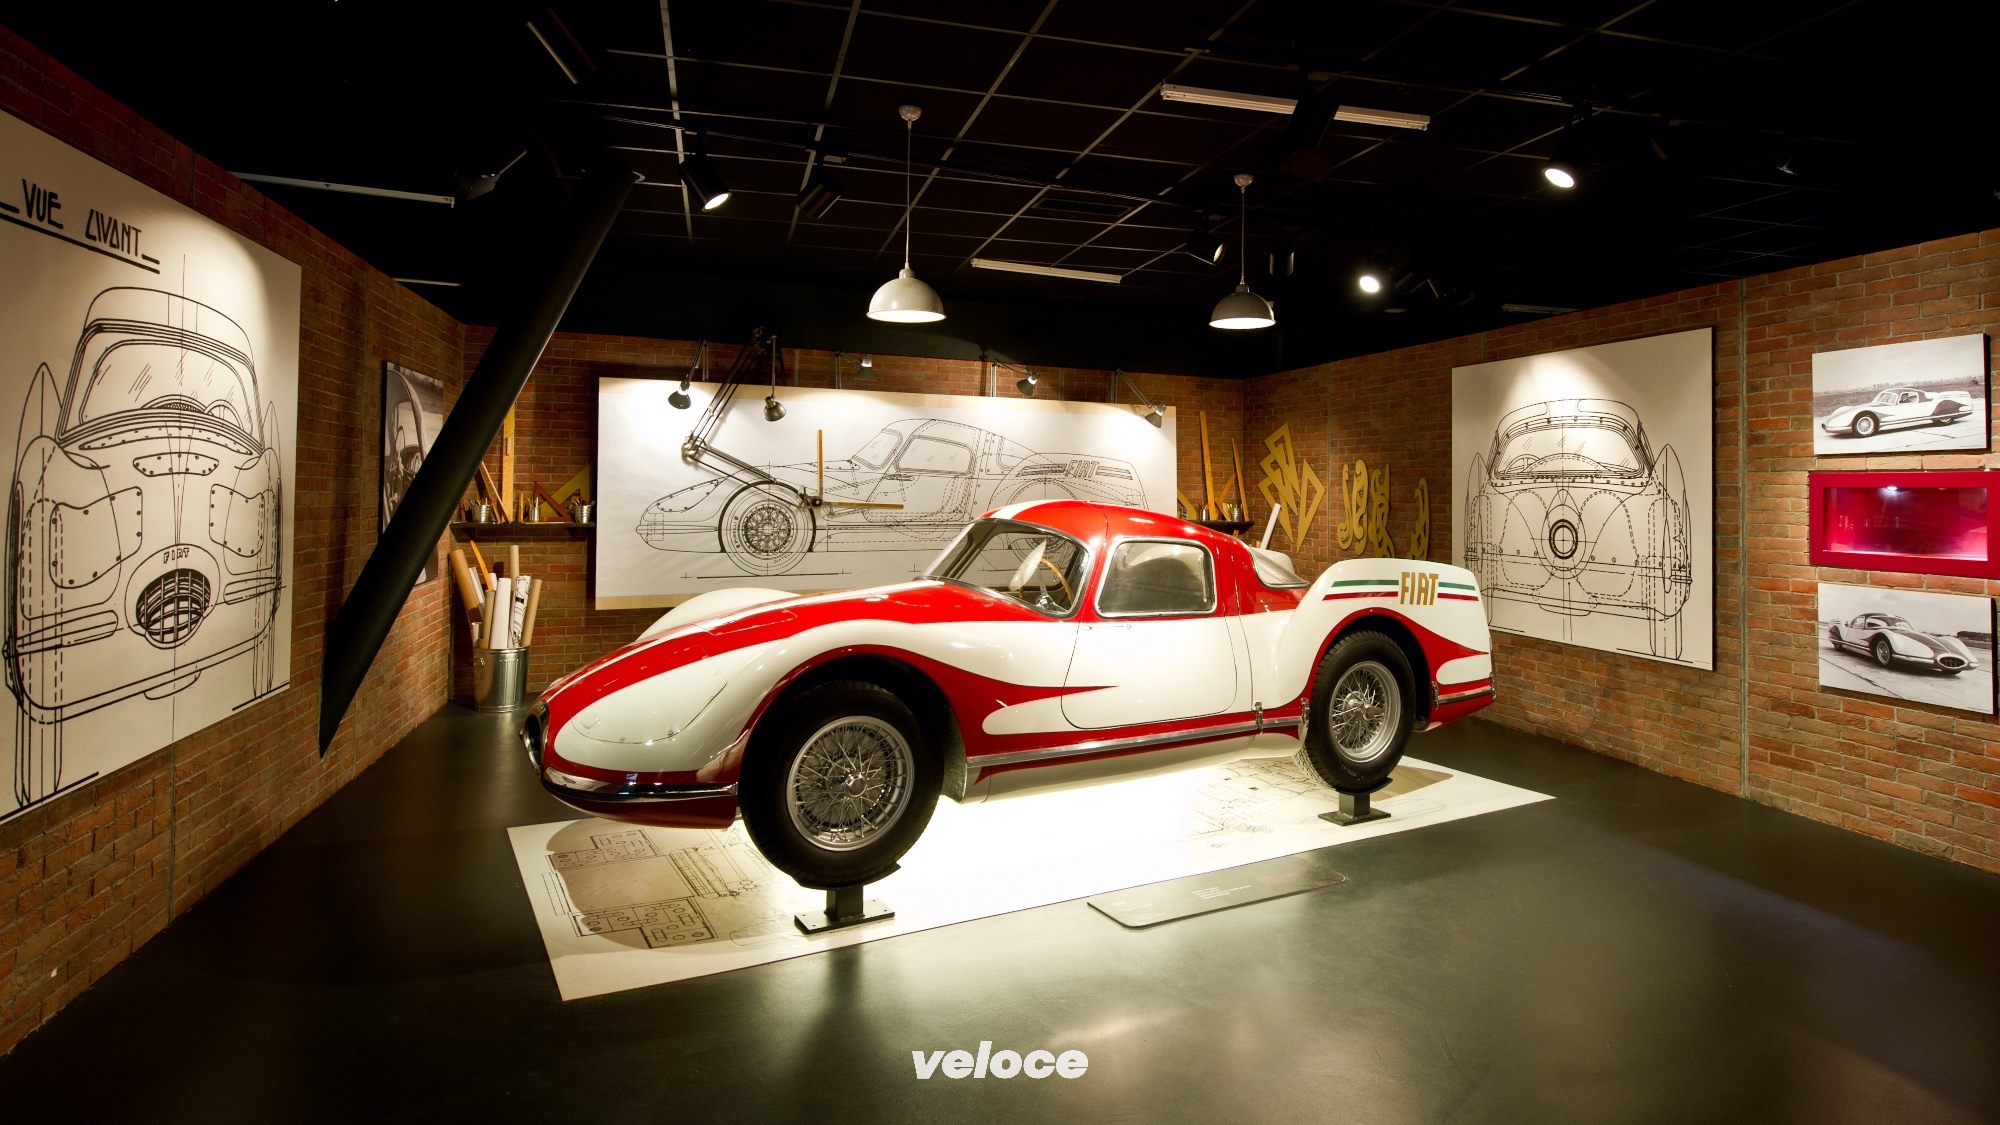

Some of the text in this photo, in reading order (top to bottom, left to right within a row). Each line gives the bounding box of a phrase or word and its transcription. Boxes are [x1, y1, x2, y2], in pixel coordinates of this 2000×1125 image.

[22, 179, 142, 256] VUE AVANT
[1065, 459, 1100, 478] FIAT
[163, 547, 190, 564] FIAT
[1400, 571, 1439, 606] FIAT
